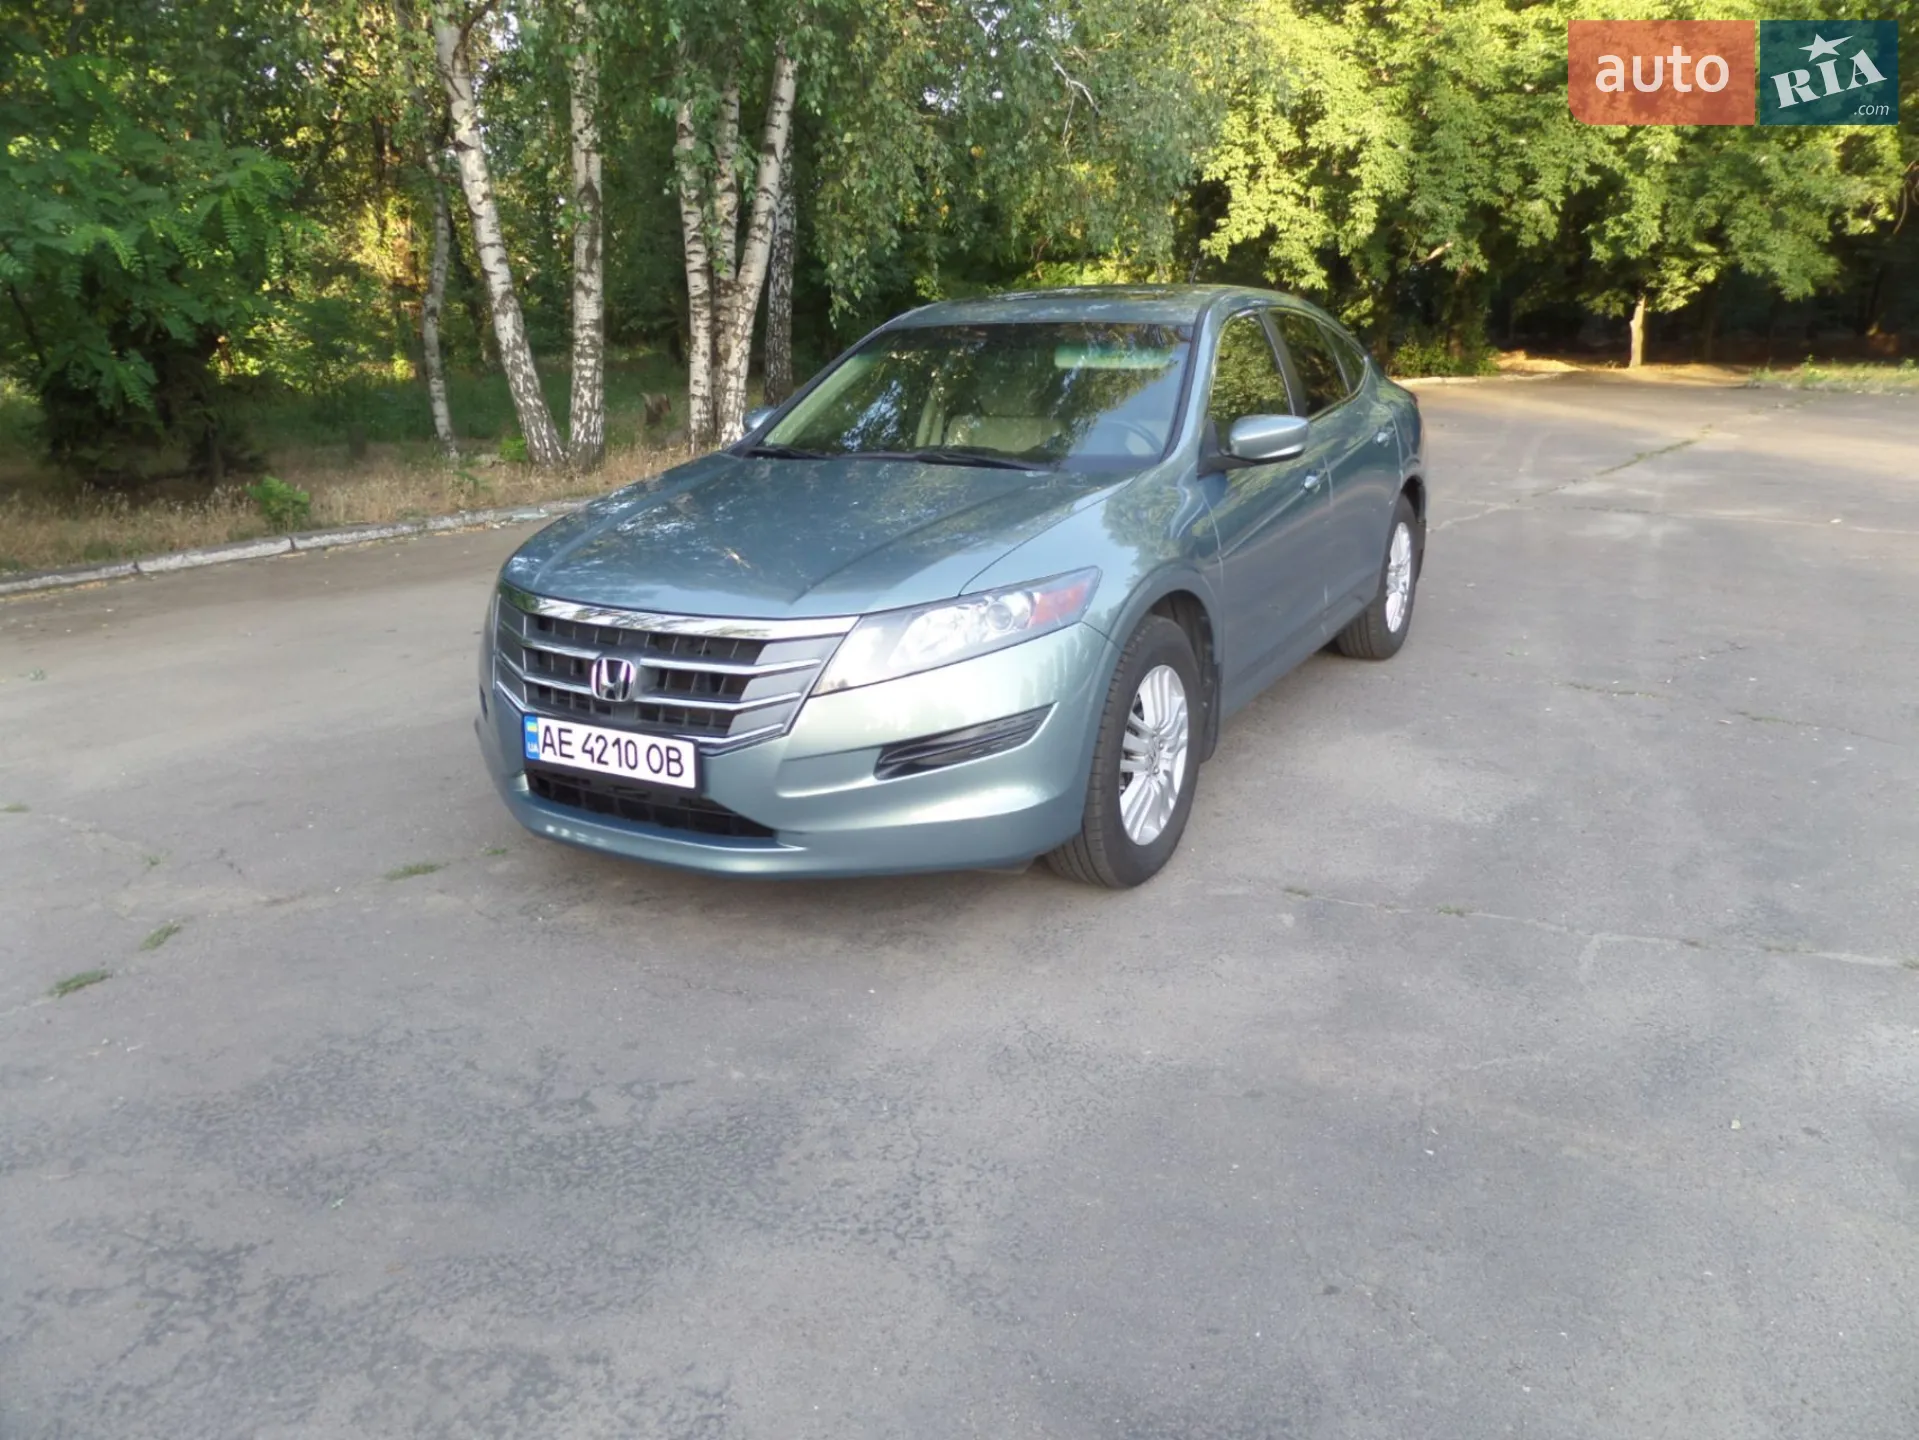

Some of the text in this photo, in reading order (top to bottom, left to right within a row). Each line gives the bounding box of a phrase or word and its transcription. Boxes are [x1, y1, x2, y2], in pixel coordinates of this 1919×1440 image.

[541, 725, 685, 778] AE 4210 OB
